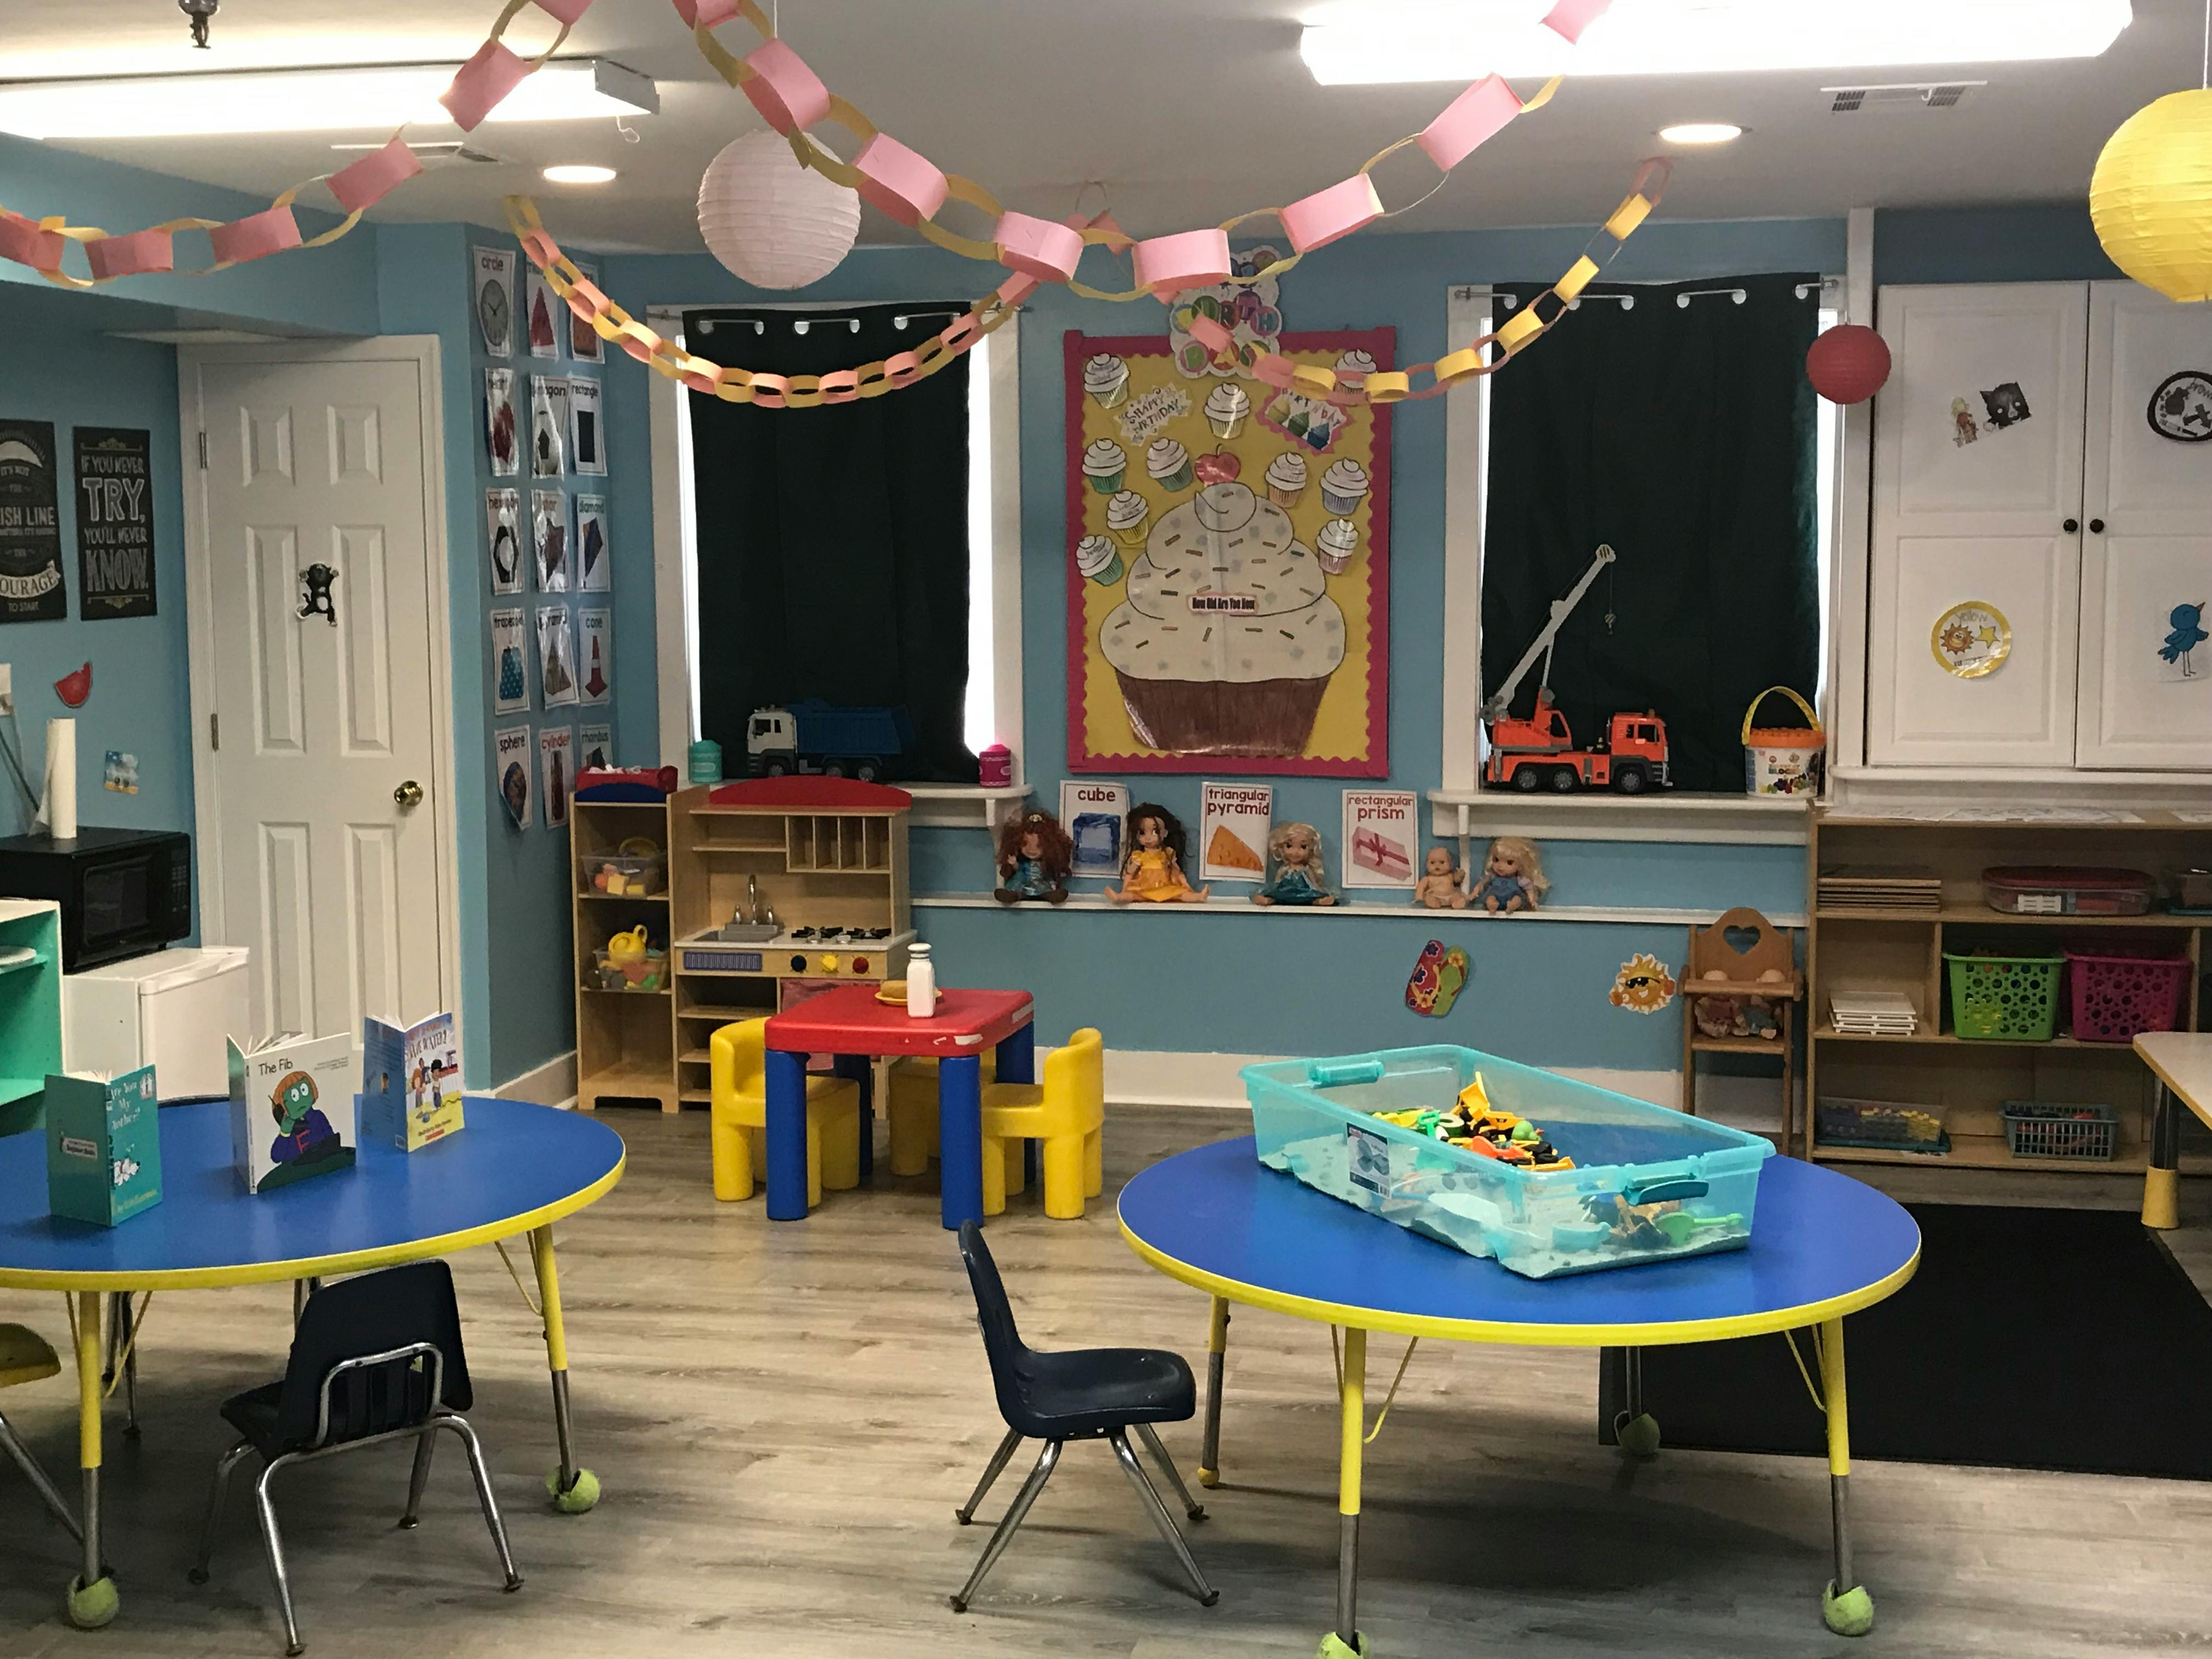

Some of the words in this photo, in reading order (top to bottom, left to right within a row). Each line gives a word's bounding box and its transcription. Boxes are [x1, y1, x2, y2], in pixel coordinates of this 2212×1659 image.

[572, 385, 599, 399] rectangle
[81, 455, 90, 472] IF
[91, 456, 114, 473] YOU
[115, 456, 144, 473] NEVER
[82, 477, 146, 523] TRY,
[579, 500, 604, 514] diamond
[26, 506, 55, 526] LINE
[84, 526, 116, 544] YOU'LL
[117, 526, 148, 544] NEVER
[86, 548, 149, 592] KNOW.
[8, 602, 18, 612] TO
[1192, 597, 1206, 610] How
[1207, 597, 1217, 610] Old
[1217, 597, 1228, 610] Are
[1229, 597, 1241, 610] You
[585, 617, 603, 629] cone
[541, 733, 571, 752] cylinder
[582, 730, 609, 742] rhombus
[500, 735, 525, 754] sphere
[1077, 787, 1116, 802] cube
[1209, 788, 1269, 802] triangular
[1348, 795, 1413, 807] rectangular
[1207, 802, 1270, 816] pyramid
[1358, 805, 1405, 822] prism
[258, 1062, 277, 1076] The
[278, 1058, 294, 1071] Fib
